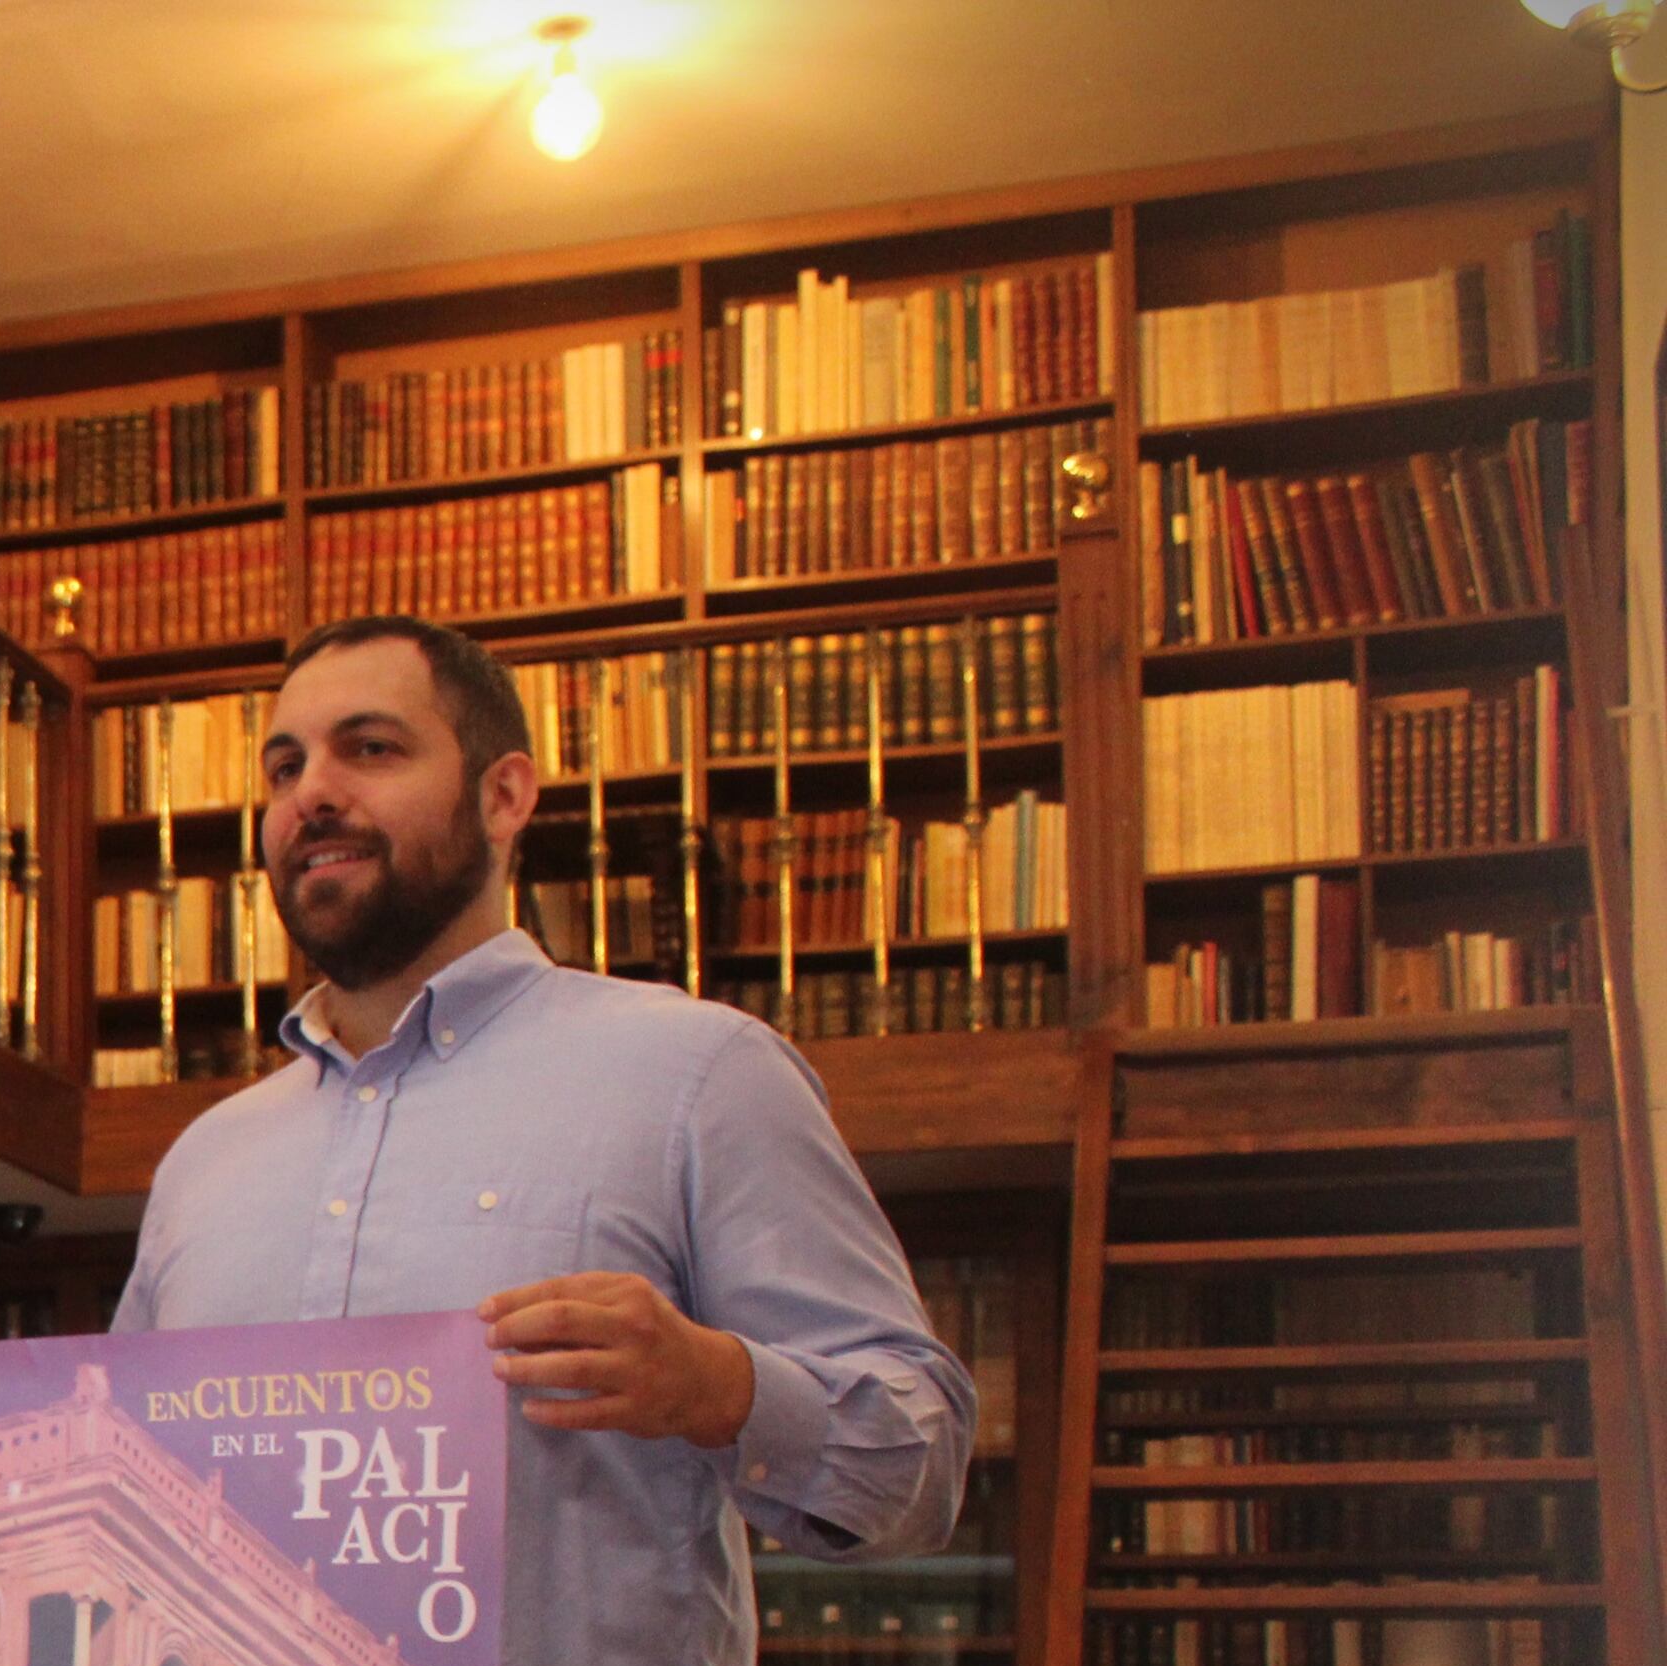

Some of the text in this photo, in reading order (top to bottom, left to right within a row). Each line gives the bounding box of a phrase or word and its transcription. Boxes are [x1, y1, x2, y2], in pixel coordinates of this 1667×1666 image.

[212, 1433, 283, 1457] EN EL
[292, 1426, 469, 1519] PAL
[331, 1502, 467, 1573] ACI
[418, 1580, 477, 1643] O
